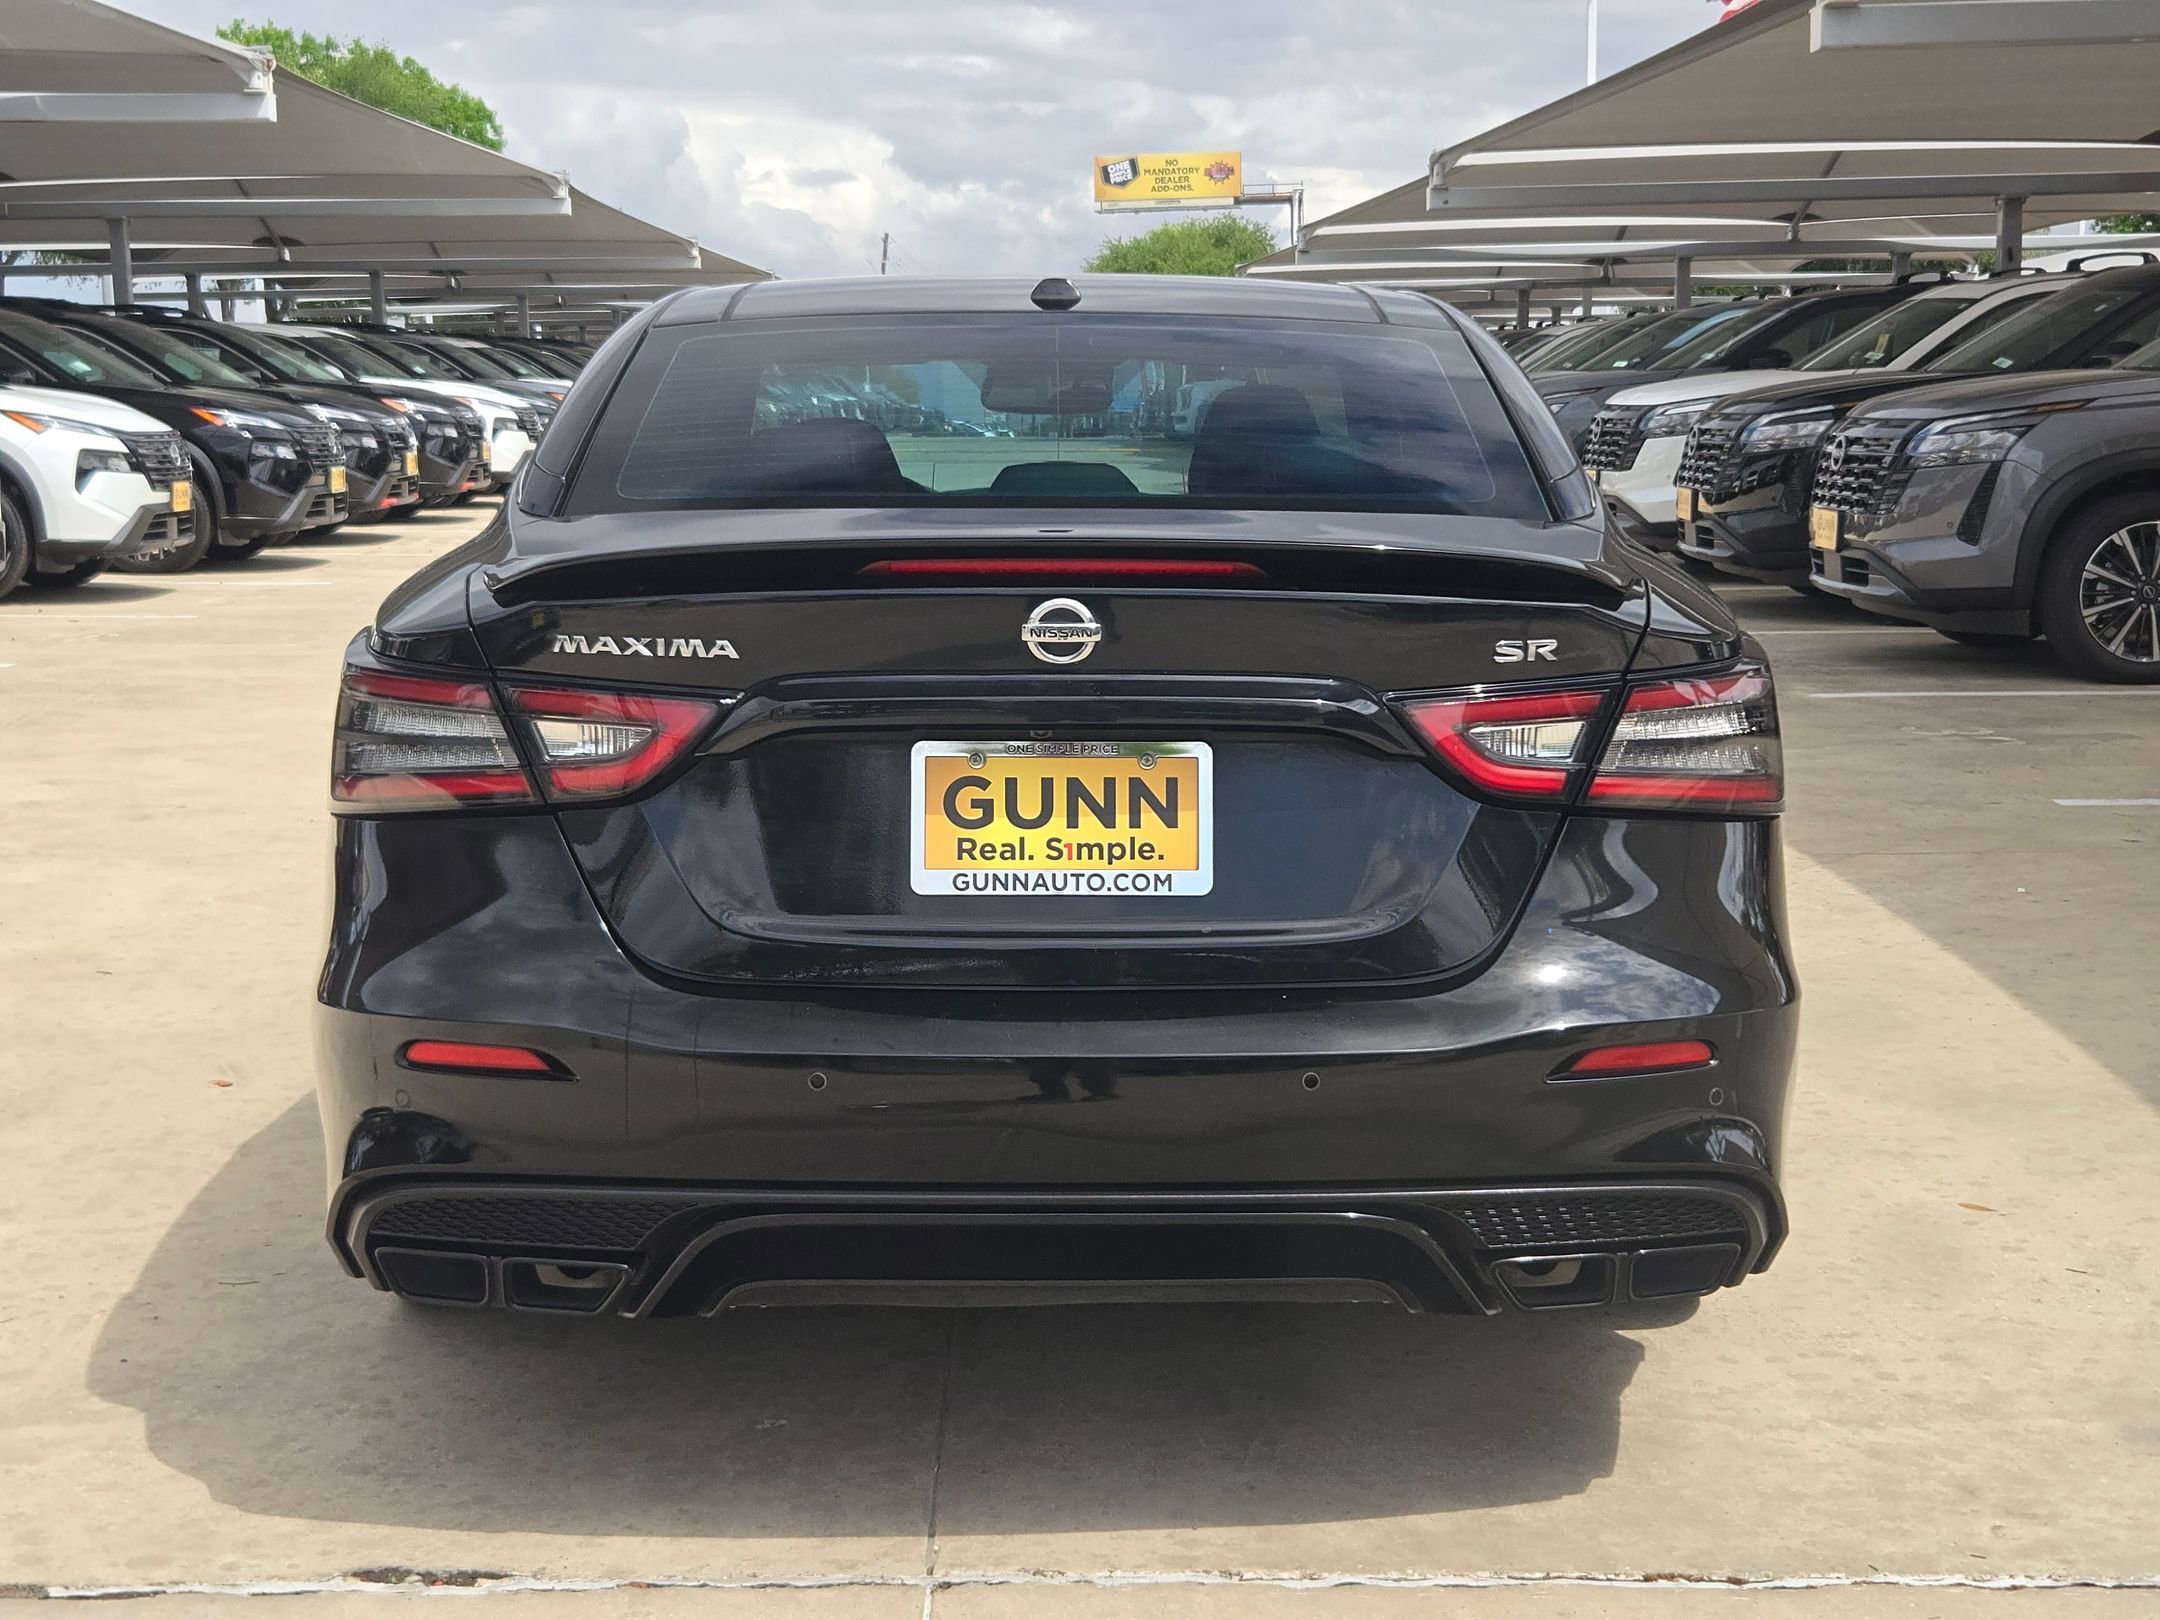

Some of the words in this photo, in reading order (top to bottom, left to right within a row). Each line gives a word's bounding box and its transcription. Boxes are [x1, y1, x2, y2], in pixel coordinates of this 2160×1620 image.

[1107, 160, 1130, 173] ONE
[1165, 159, 1178, 167] NO
[1143, 167, 1200, 176] MANDATORY
[1154, 176, 1190, 184] DEALER
[1151, 184, 1195, 193] ADD-ONS.
[1030, 627, 1093, 638] NISSAN
[553, 634, 740, 659] MAXIMA
[1493, 639, 1558, 663] SR
[1007, 744, 1033, 754] ONE
[1036, 744, 1080, 754] SIMPLE
[1083, 744, 1119, 754] PRICE
[943, 775, 1179, 830] GUNN
[957, 837, 1034, 861] Real.
[952, 872, 1173, 892] GUNNAUTO.COM
